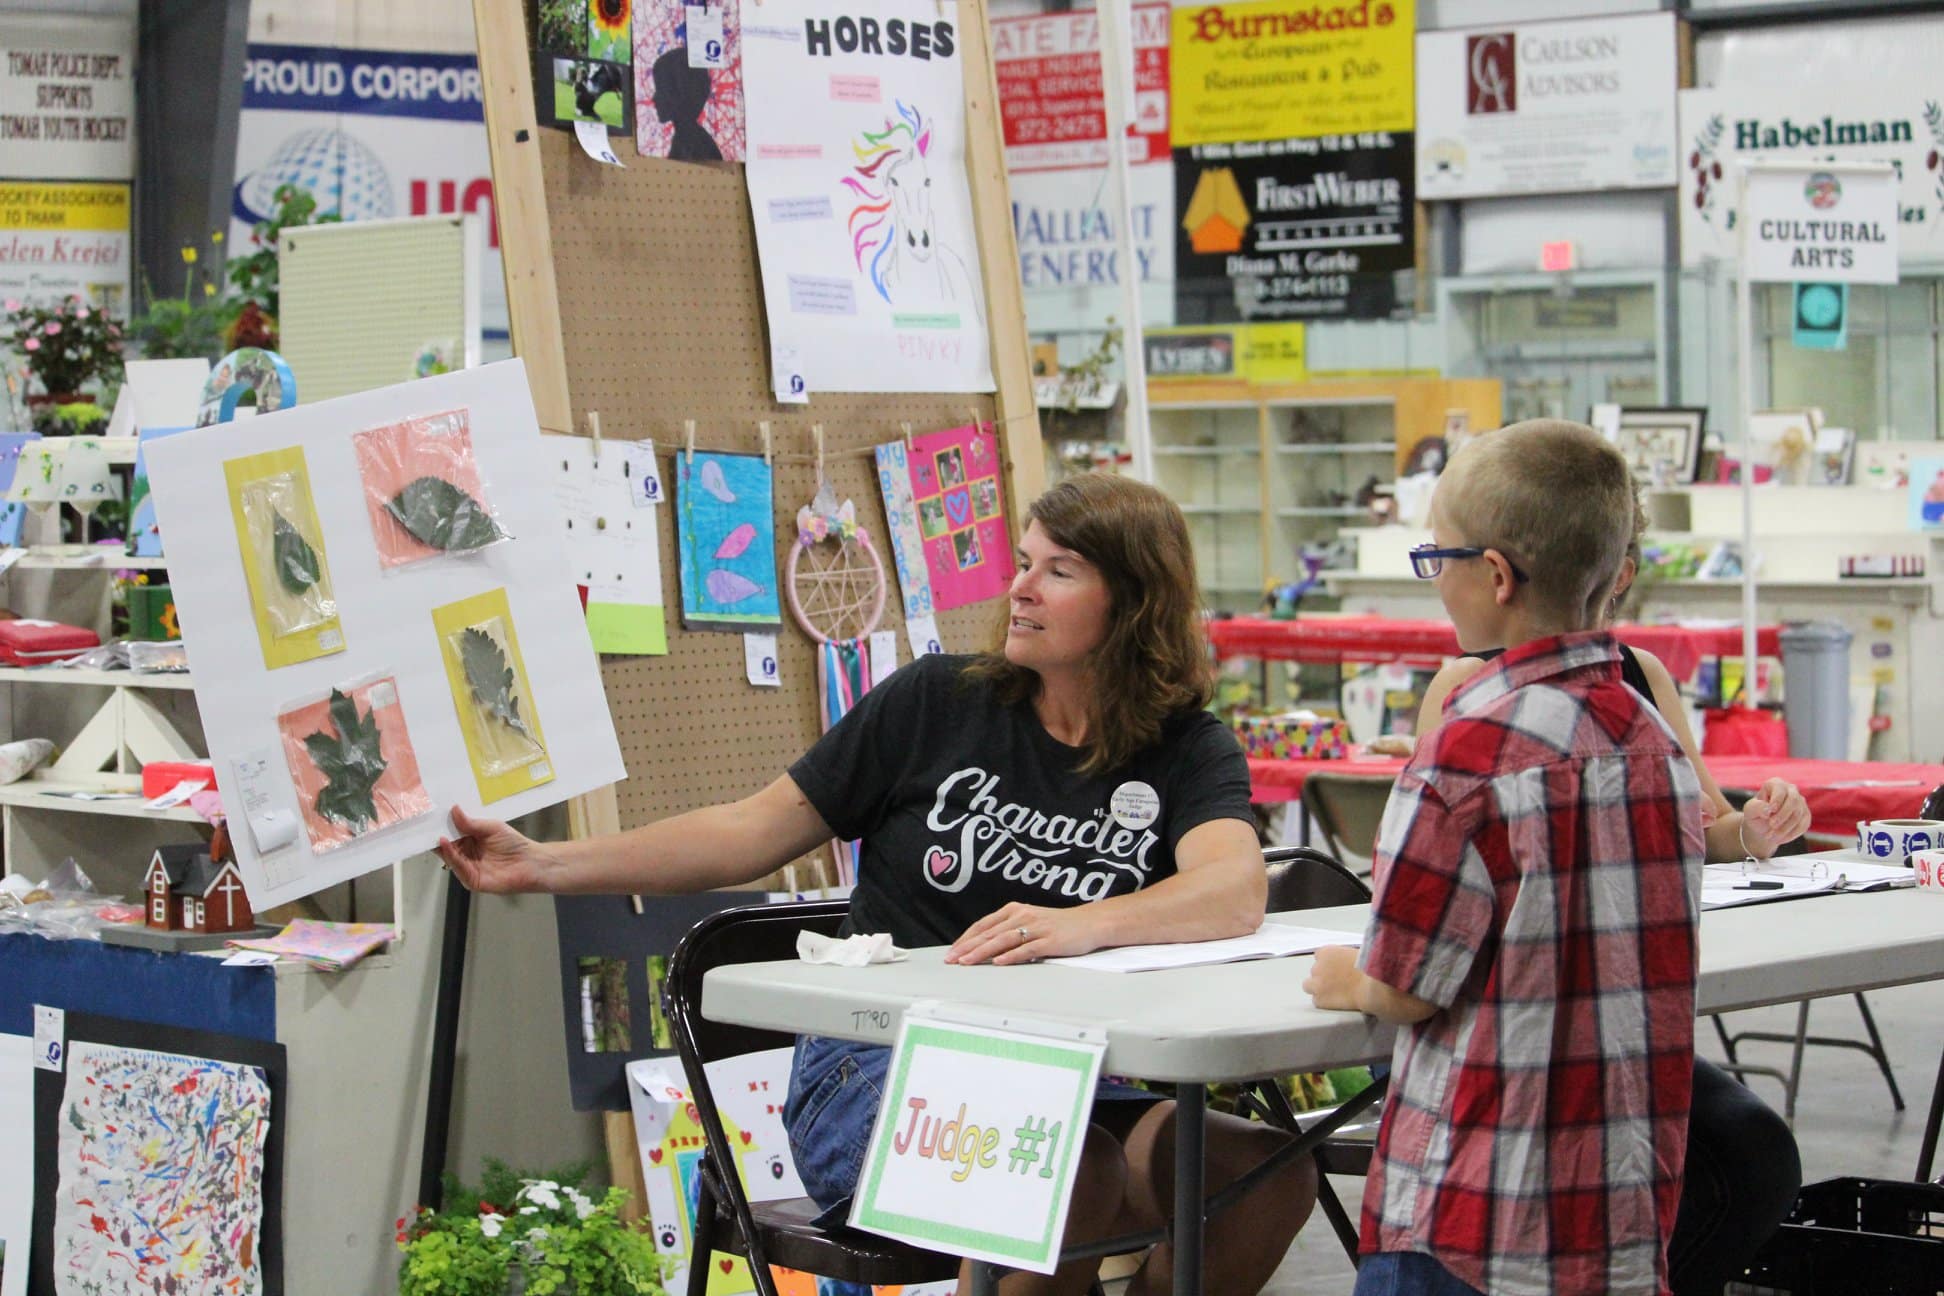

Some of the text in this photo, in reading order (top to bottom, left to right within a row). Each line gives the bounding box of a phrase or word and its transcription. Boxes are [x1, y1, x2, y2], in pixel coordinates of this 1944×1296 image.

[805, 16, 955, 61] HORSES
[1521, 36, 1619, 65] CARLSON
[1524, 71, 1620, 98] ADVISORS
[1735, 115, 1914, 151] Habelman
[1760, 219, 1887, 243] CULTURAL
[1791, 247, 1855, 269] ARTS
[926, 766, 1159, 872] Character
[923, 812, 1145, 903] Strong
[895, 1097, 1063, 1183] Judge #1
